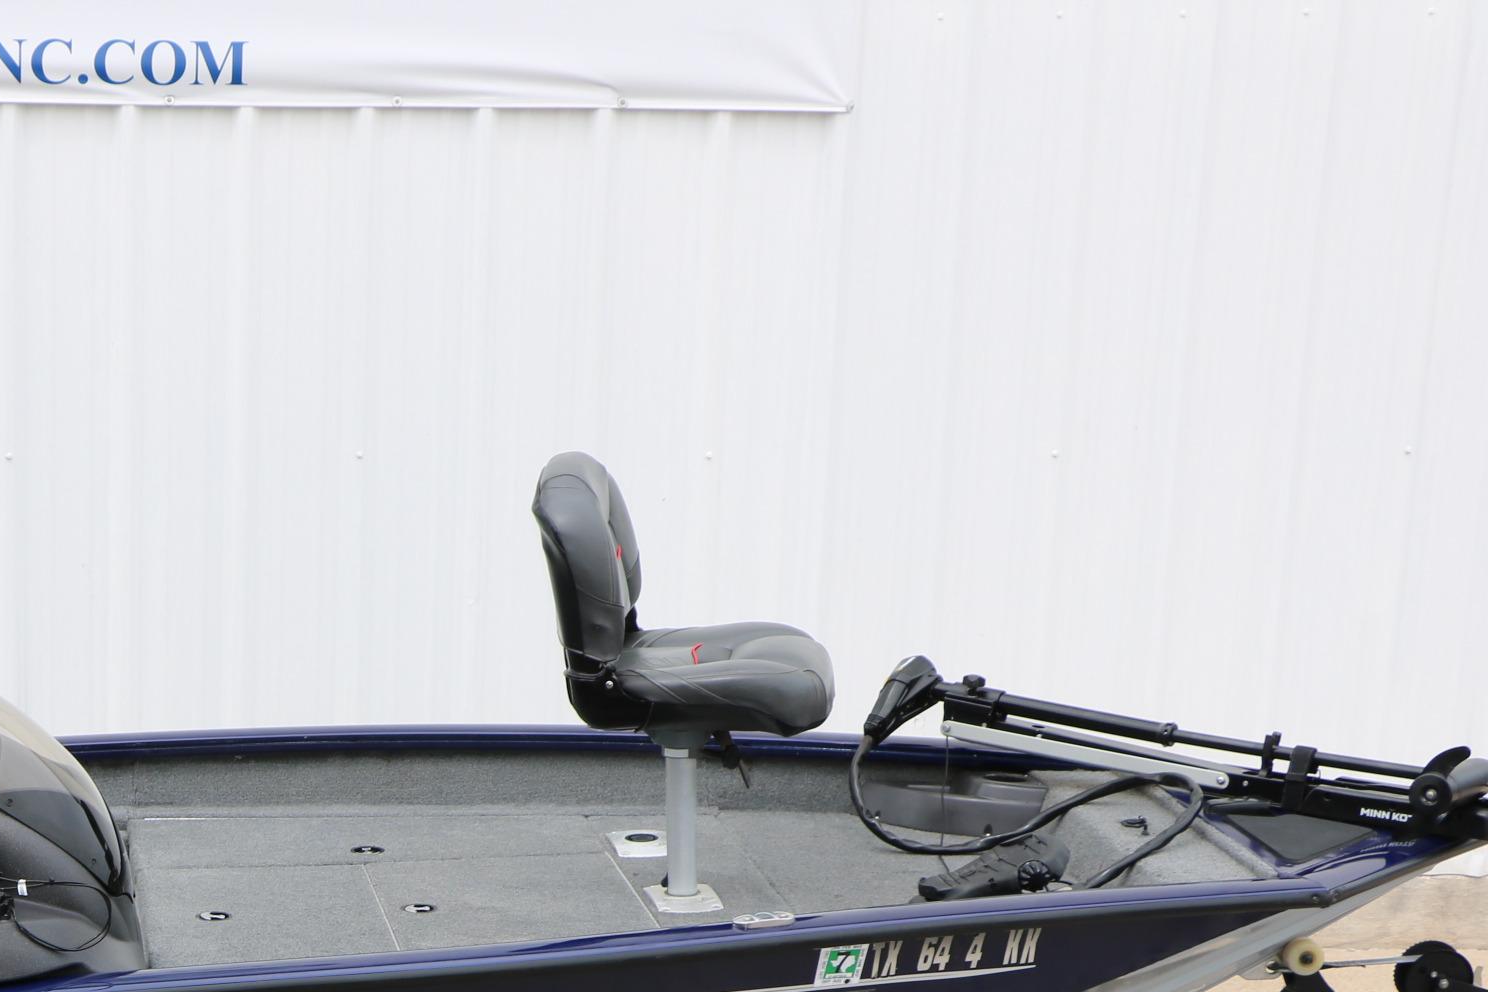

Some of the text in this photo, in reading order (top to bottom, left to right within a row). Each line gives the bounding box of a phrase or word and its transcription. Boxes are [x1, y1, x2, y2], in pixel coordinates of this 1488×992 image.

[1359, 807, 1413, 822] MINN KO
[835, 950, 851, 973] 7
[871, 940, 903, 979] TX
